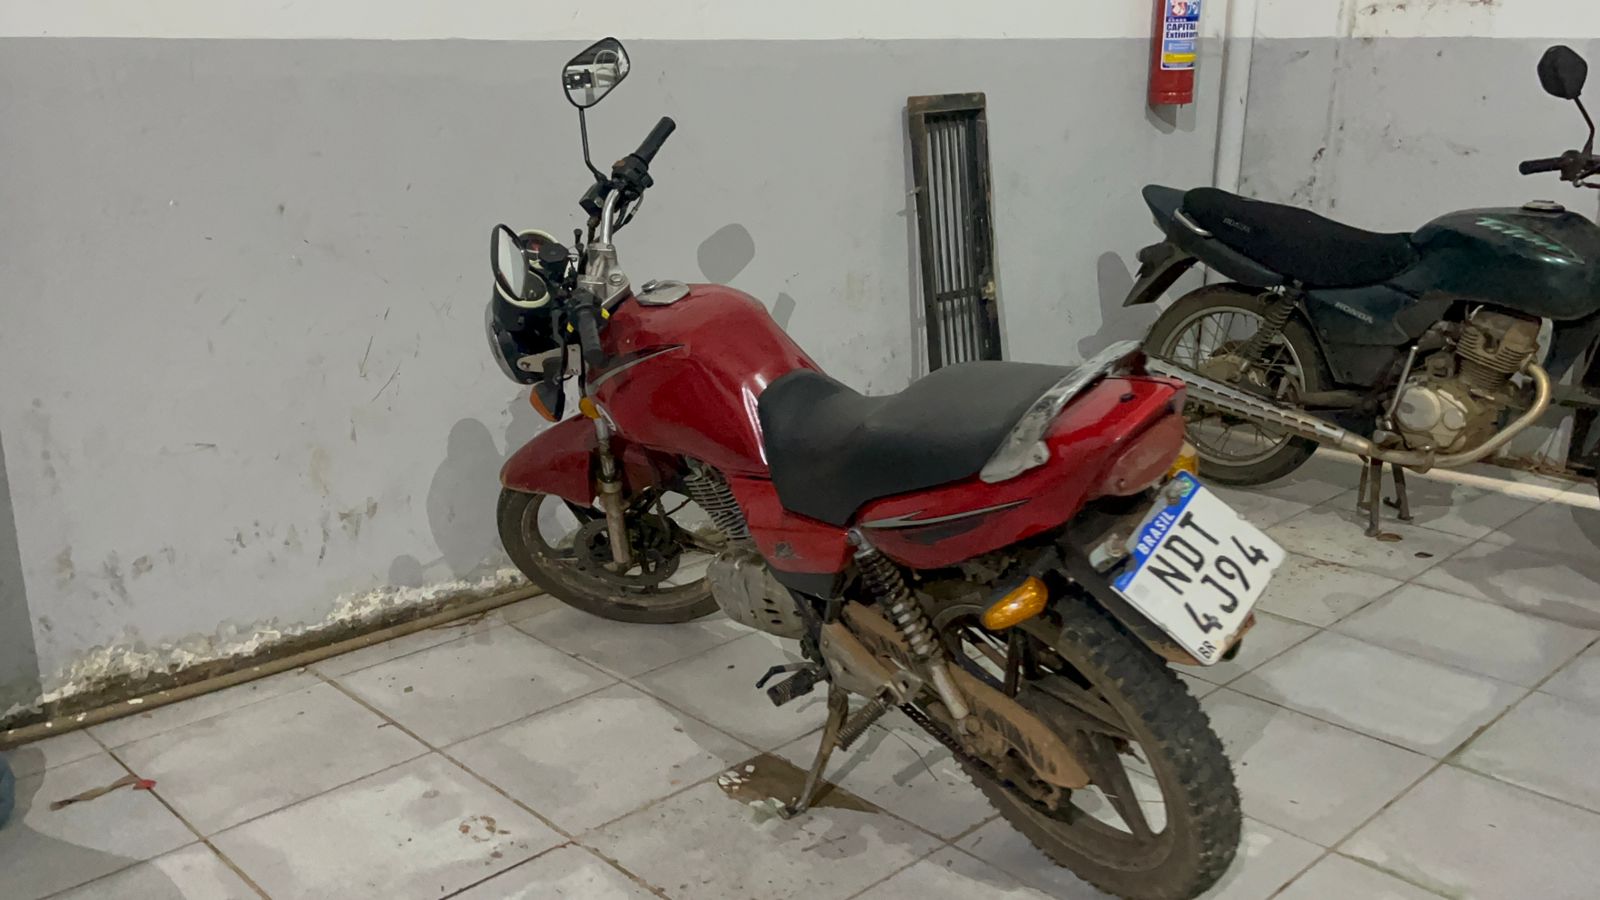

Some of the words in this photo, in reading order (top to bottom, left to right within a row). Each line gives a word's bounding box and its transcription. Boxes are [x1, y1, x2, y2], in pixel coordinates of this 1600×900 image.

[1136, 511, 1176, 556] BRASIL
[1147, 511, 1220, 596] NDT
[1184, 535, 1270, 634] 4J94
[1199, 641, 1217, 660] BR
